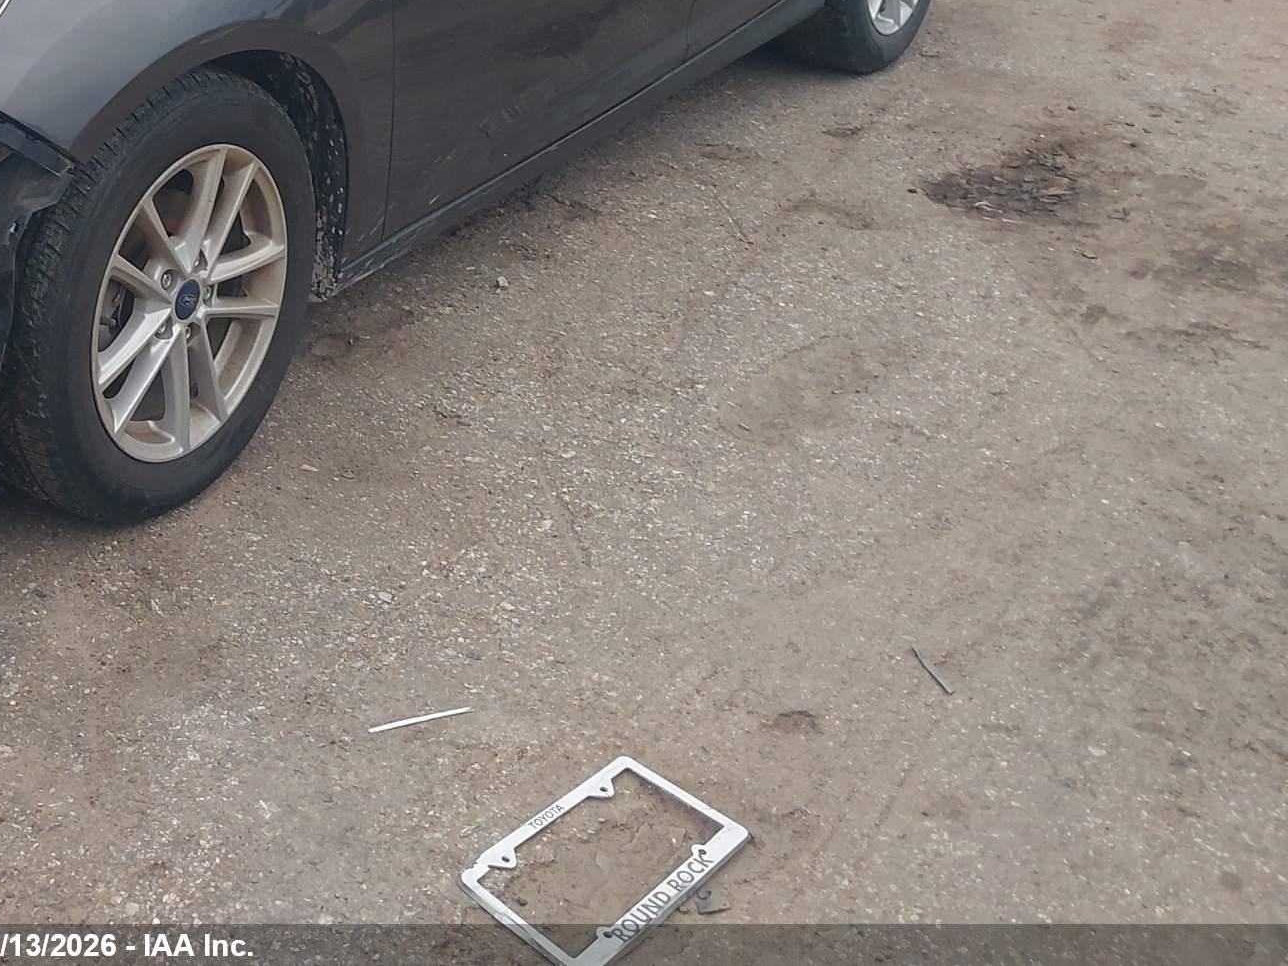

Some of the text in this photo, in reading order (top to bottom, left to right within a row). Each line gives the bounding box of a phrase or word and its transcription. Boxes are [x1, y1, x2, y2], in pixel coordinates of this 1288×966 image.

[527, 803, 565, 831] TOYOTA
[612, 854, 715, 943] ROUND ROCK
